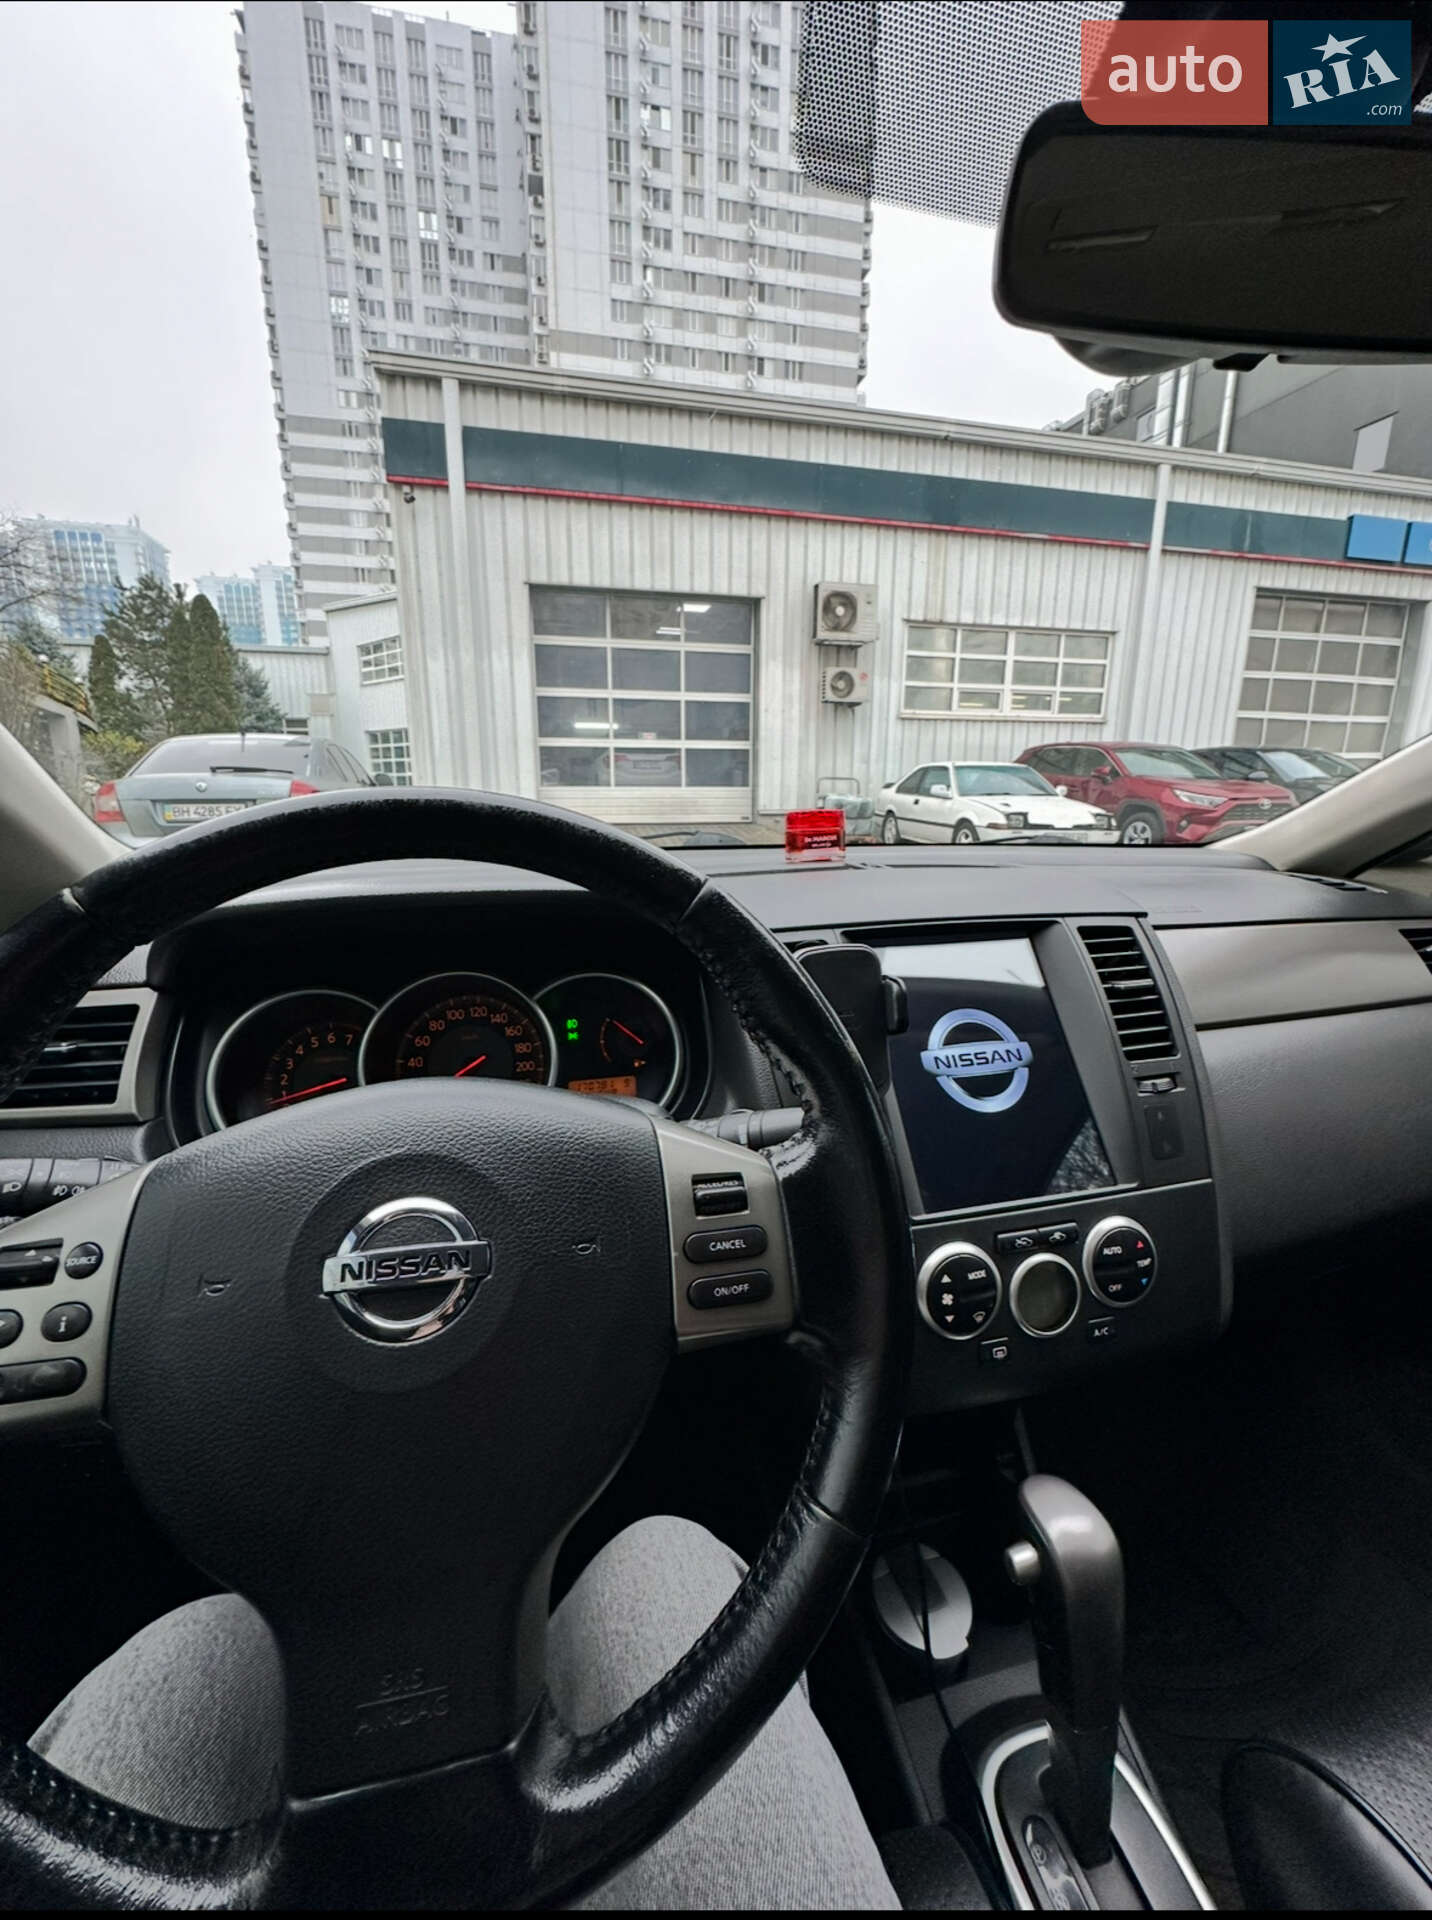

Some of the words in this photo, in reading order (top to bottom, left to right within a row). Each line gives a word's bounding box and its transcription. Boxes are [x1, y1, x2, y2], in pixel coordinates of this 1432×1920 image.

[172, 806, 190, 817] BH
[193, 806, 222, 817] 4285
[446, 1009, 465, 1021] 100
[470, 1006, 488, 1017] 120
[490, 1013, 508, 1024] 140
[428, 1020, 445, 1031] 80
[505, 1025, 523, 1037] 160
[311, 1036, 319, 1048] 5
[327, 1032, 336, 1043] 6
[344, 1034, 353, 1046] 7
[414, 1035, 431, 1047] 60
[296, 1044, 304, 1055] 4
[514, 1042, 532, 1054] 180
[287, 1058, 294, 1069] 3
[408, 1056, 423, 1068] 40
[934, 1048, 1023, 1069] NISSAN
[516, 1061, 535, 1072] 200
[280, 1074, 288, 1085] 2
[709, 1239, 747, 1251] CANCEL
[1103, 1246, 1122, 1256] AUTO
[66, 1255, 97, 1267] SOURCE
[340, 1250, 471, 1283] NISSAN
[967, 1269, 987, 1280] MODE
[713, 1283, 750, 1297] ON/OFF
[1108, 1283, 1122, 1293] OFF
[1094, 1326, 1109, 1337] A/C
